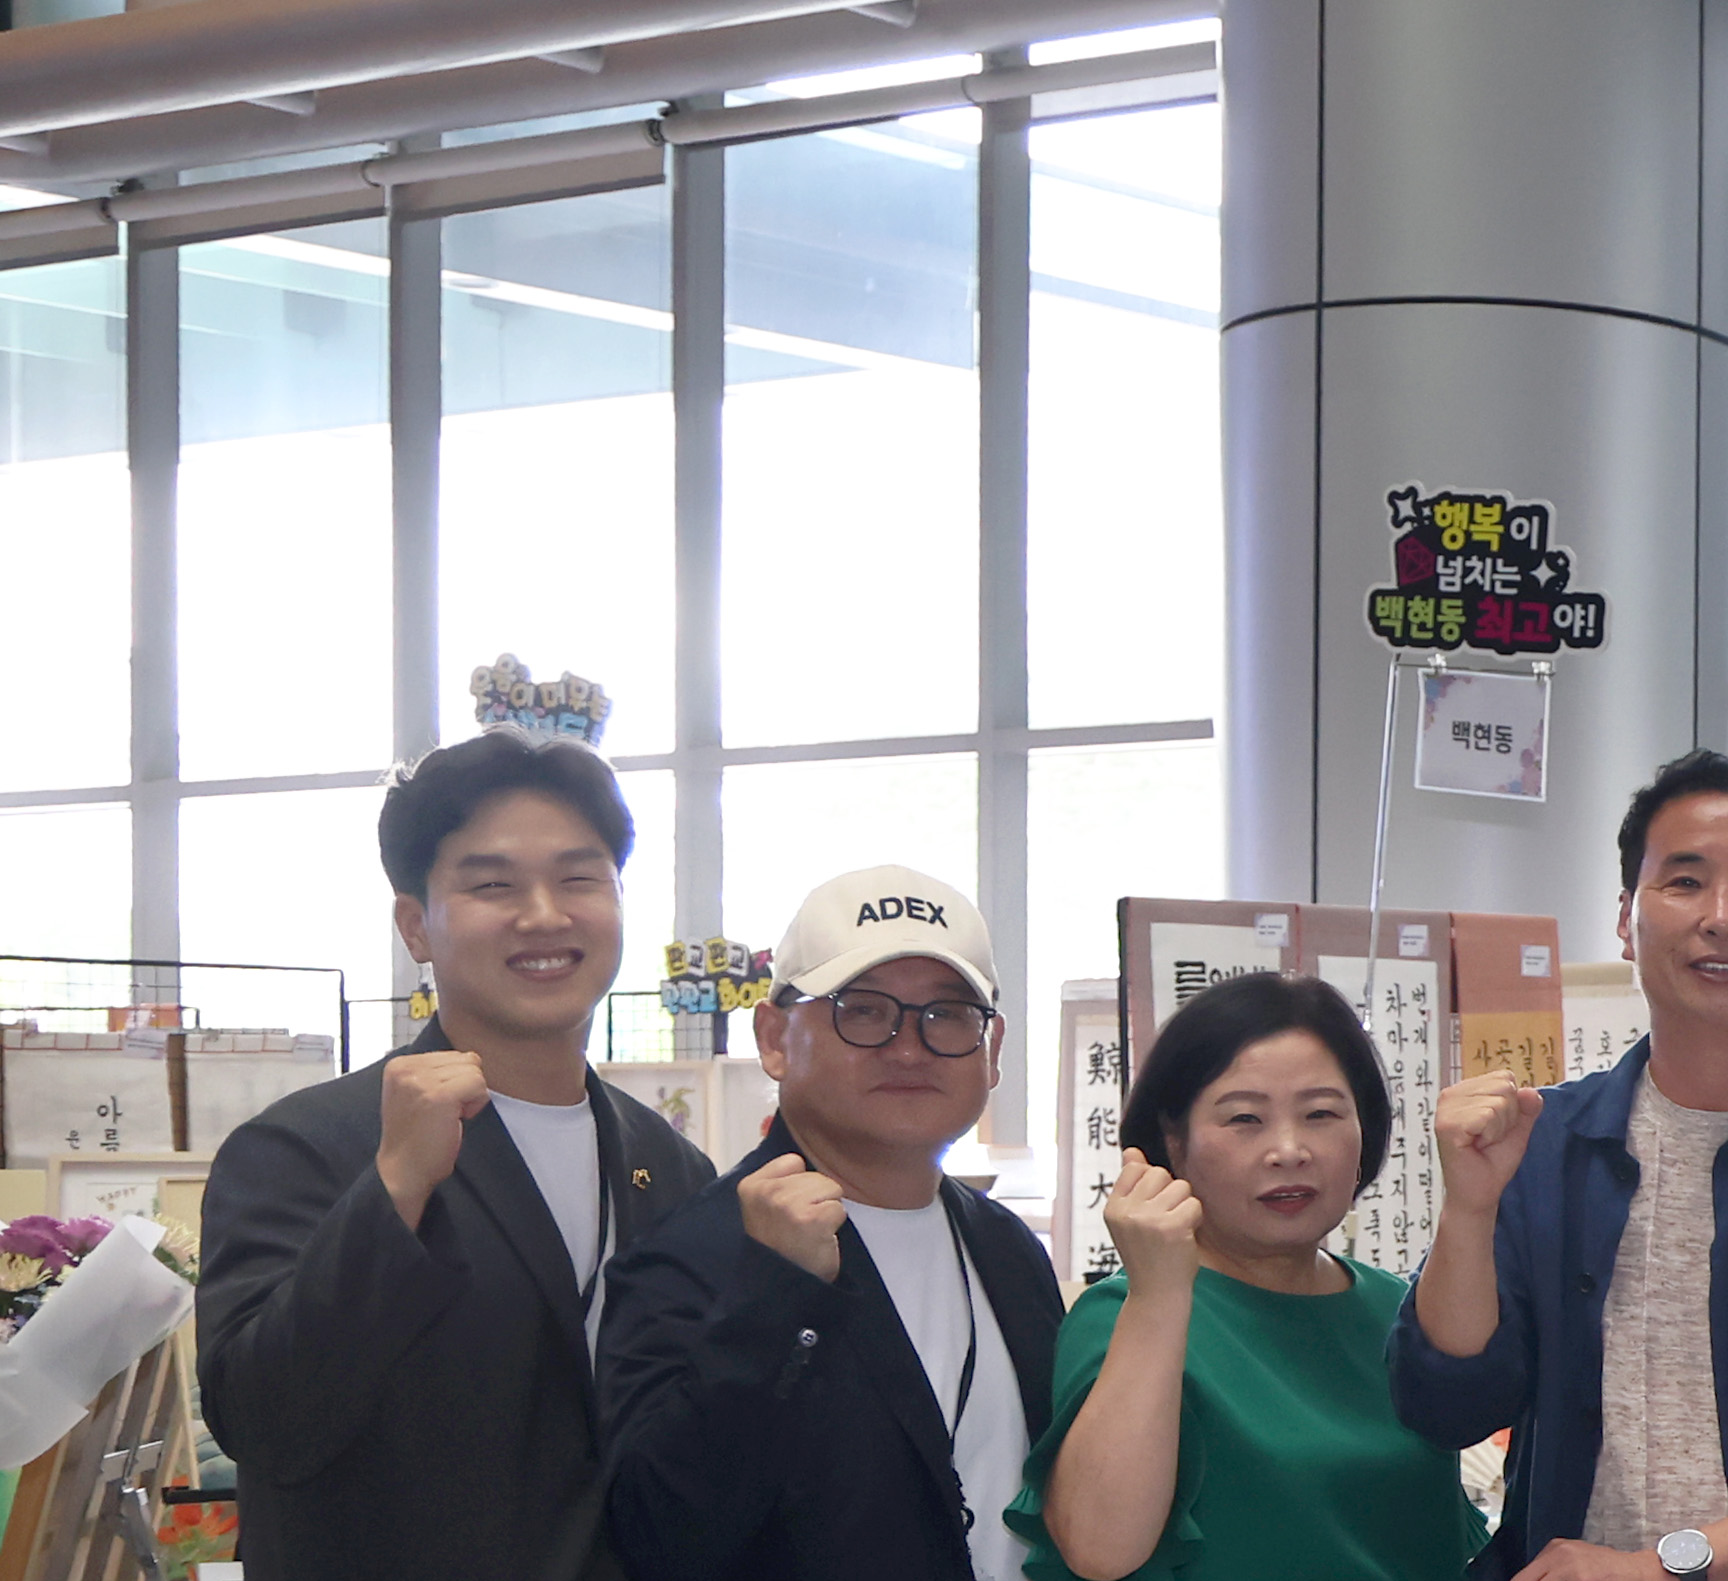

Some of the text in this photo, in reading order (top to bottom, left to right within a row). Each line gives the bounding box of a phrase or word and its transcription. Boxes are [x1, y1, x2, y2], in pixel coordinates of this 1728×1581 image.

[1433, 500, 1540, 552] 행복이
[1436, 554, 1522, 595] 넘치는
[1374, 595, 1597, 645] 백현동 최고야!
[1451, 720, 1514, 755] 백현동
[856, 896, 948, 928] ADEX
